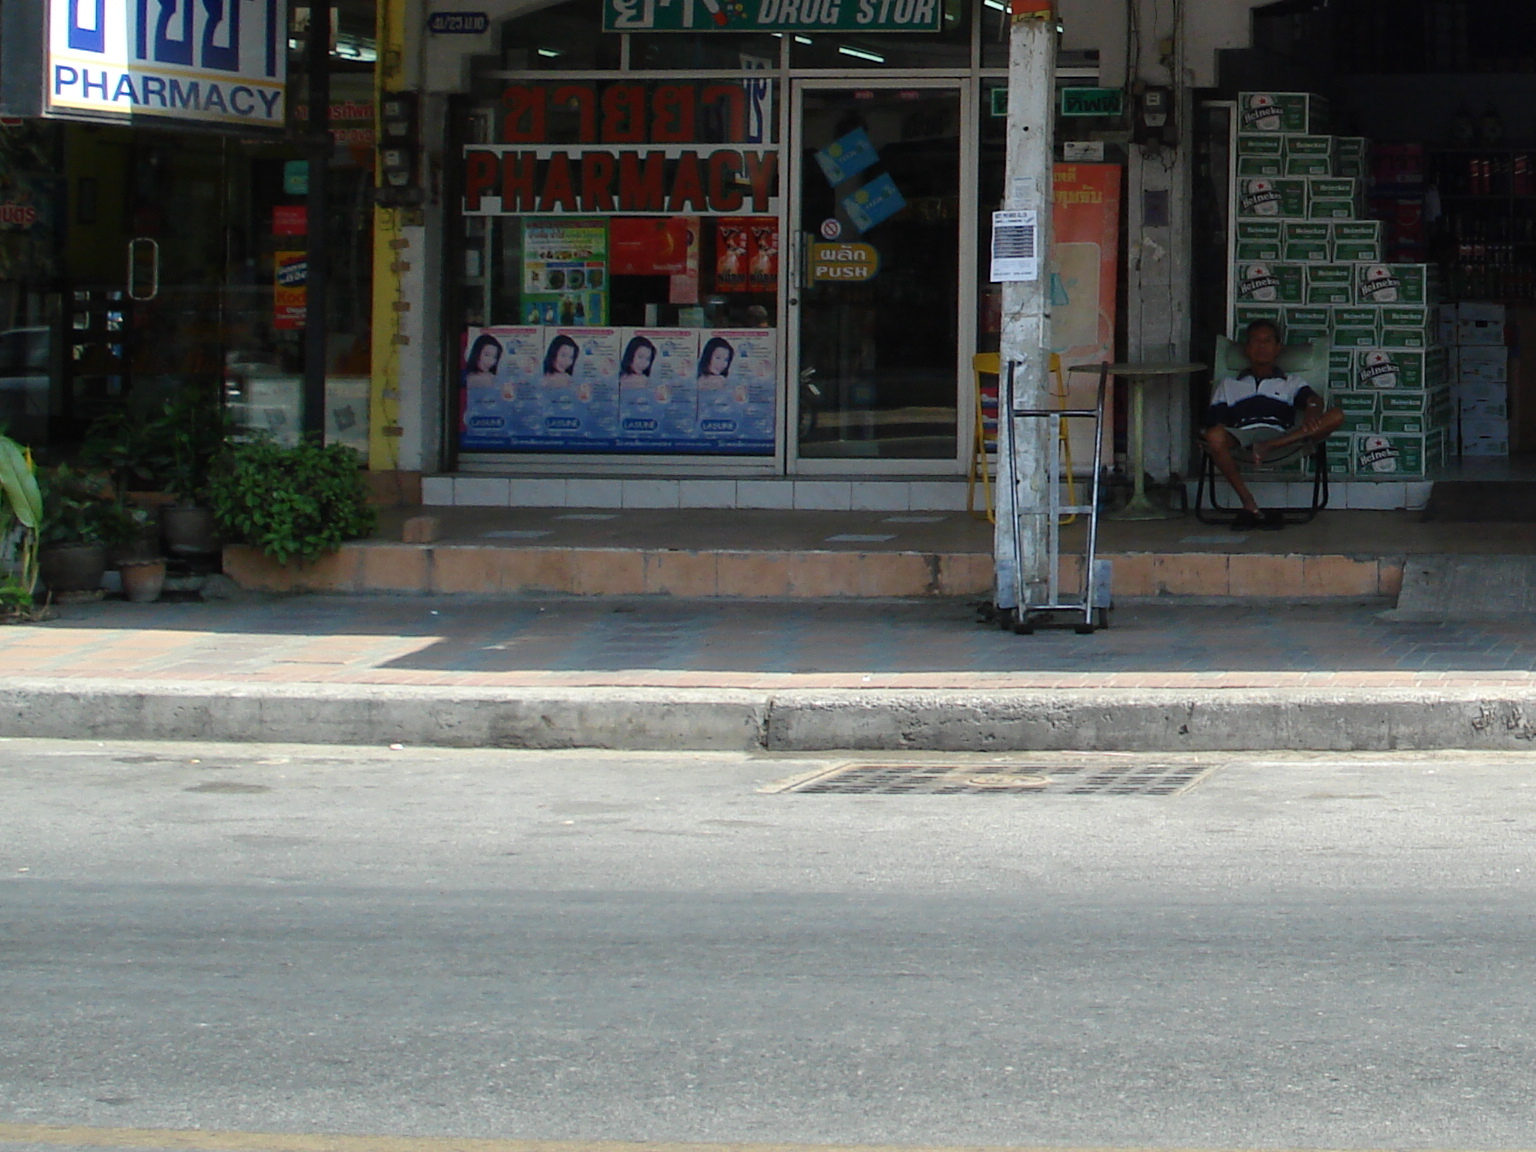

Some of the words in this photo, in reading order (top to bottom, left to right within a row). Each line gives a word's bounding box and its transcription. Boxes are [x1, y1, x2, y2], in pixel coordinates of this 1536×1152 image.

[54, 65, 280, 118] PHARMACY
[502, 85, 747, 144] ขายยา
[465, 150, 779, 213] PHARMACY
[815, 265, 867, 278] PUSH
[820, 245, 866, 261] ผลัก
